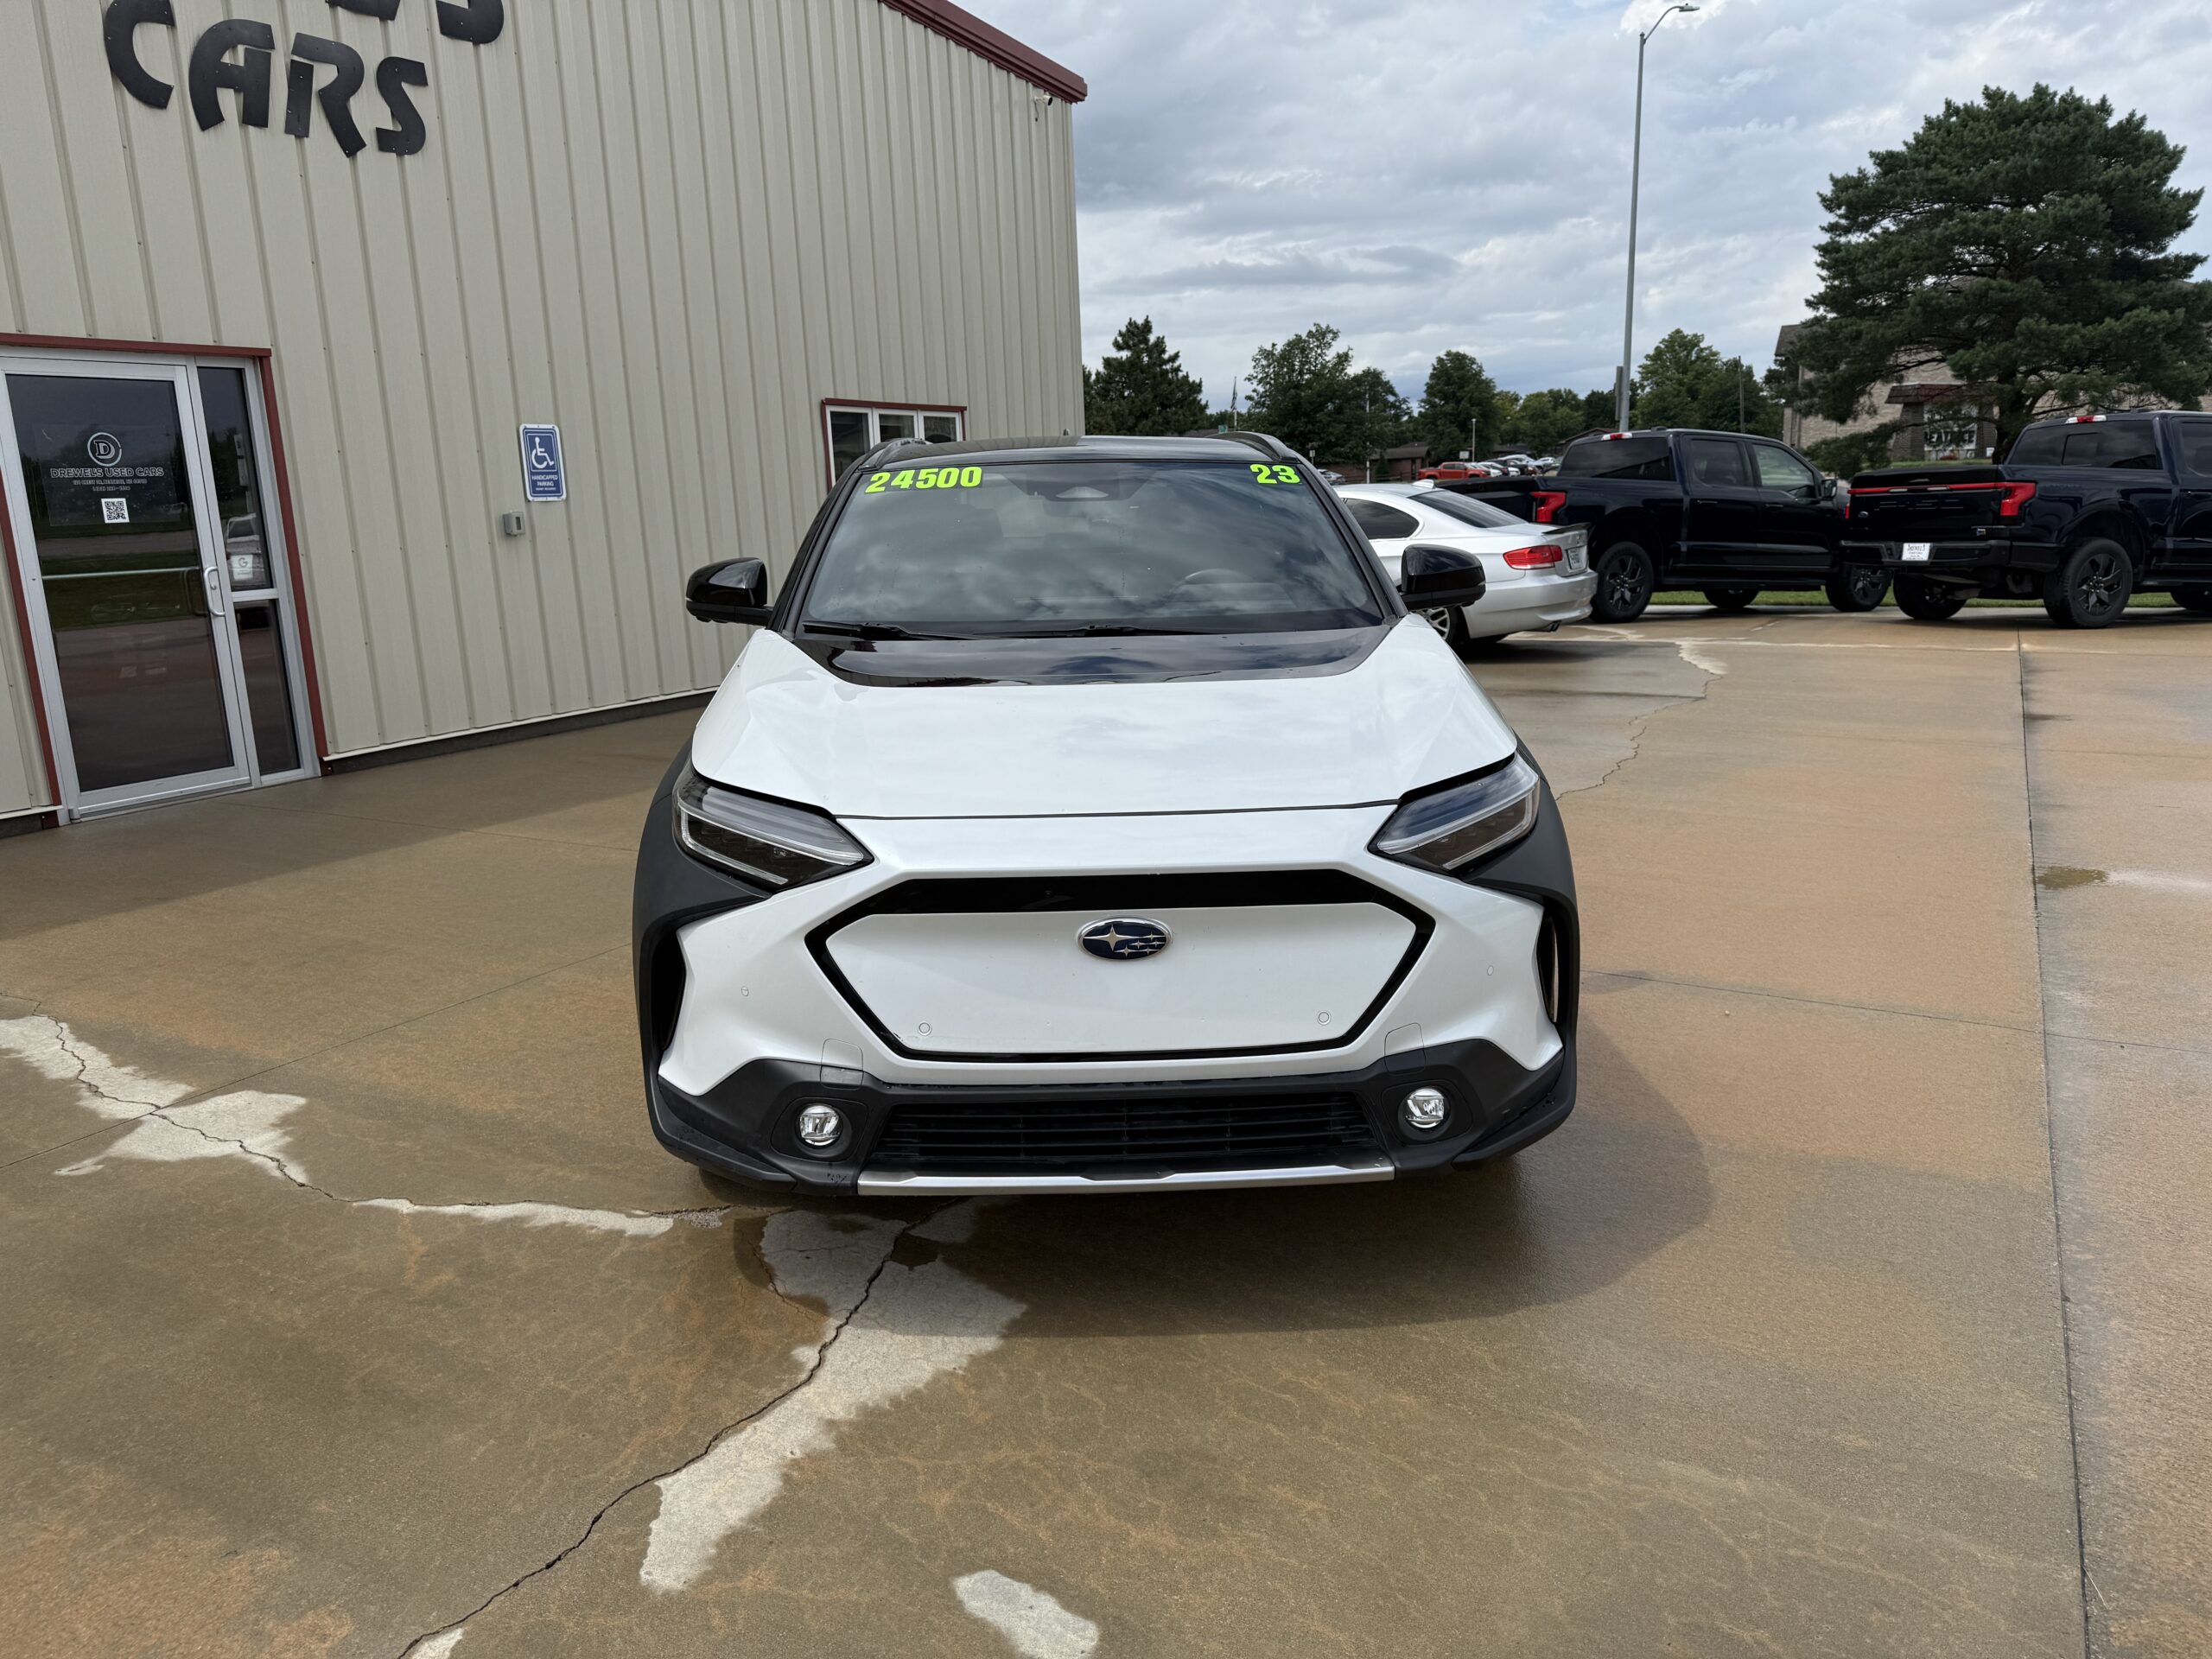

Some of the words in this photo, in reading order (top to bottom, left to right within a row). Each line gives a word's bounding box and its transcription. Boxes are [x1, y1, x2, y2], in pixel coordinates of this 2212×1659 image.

[104, 0, 429, 158] CARS
[93, 439, 116, 460] D
[105, 467, 134, 477] USED
[136, 467, 164, 477] CARS
[865, 466, 982, 493] 24500
[1249, 463, 1300, 484] 23
